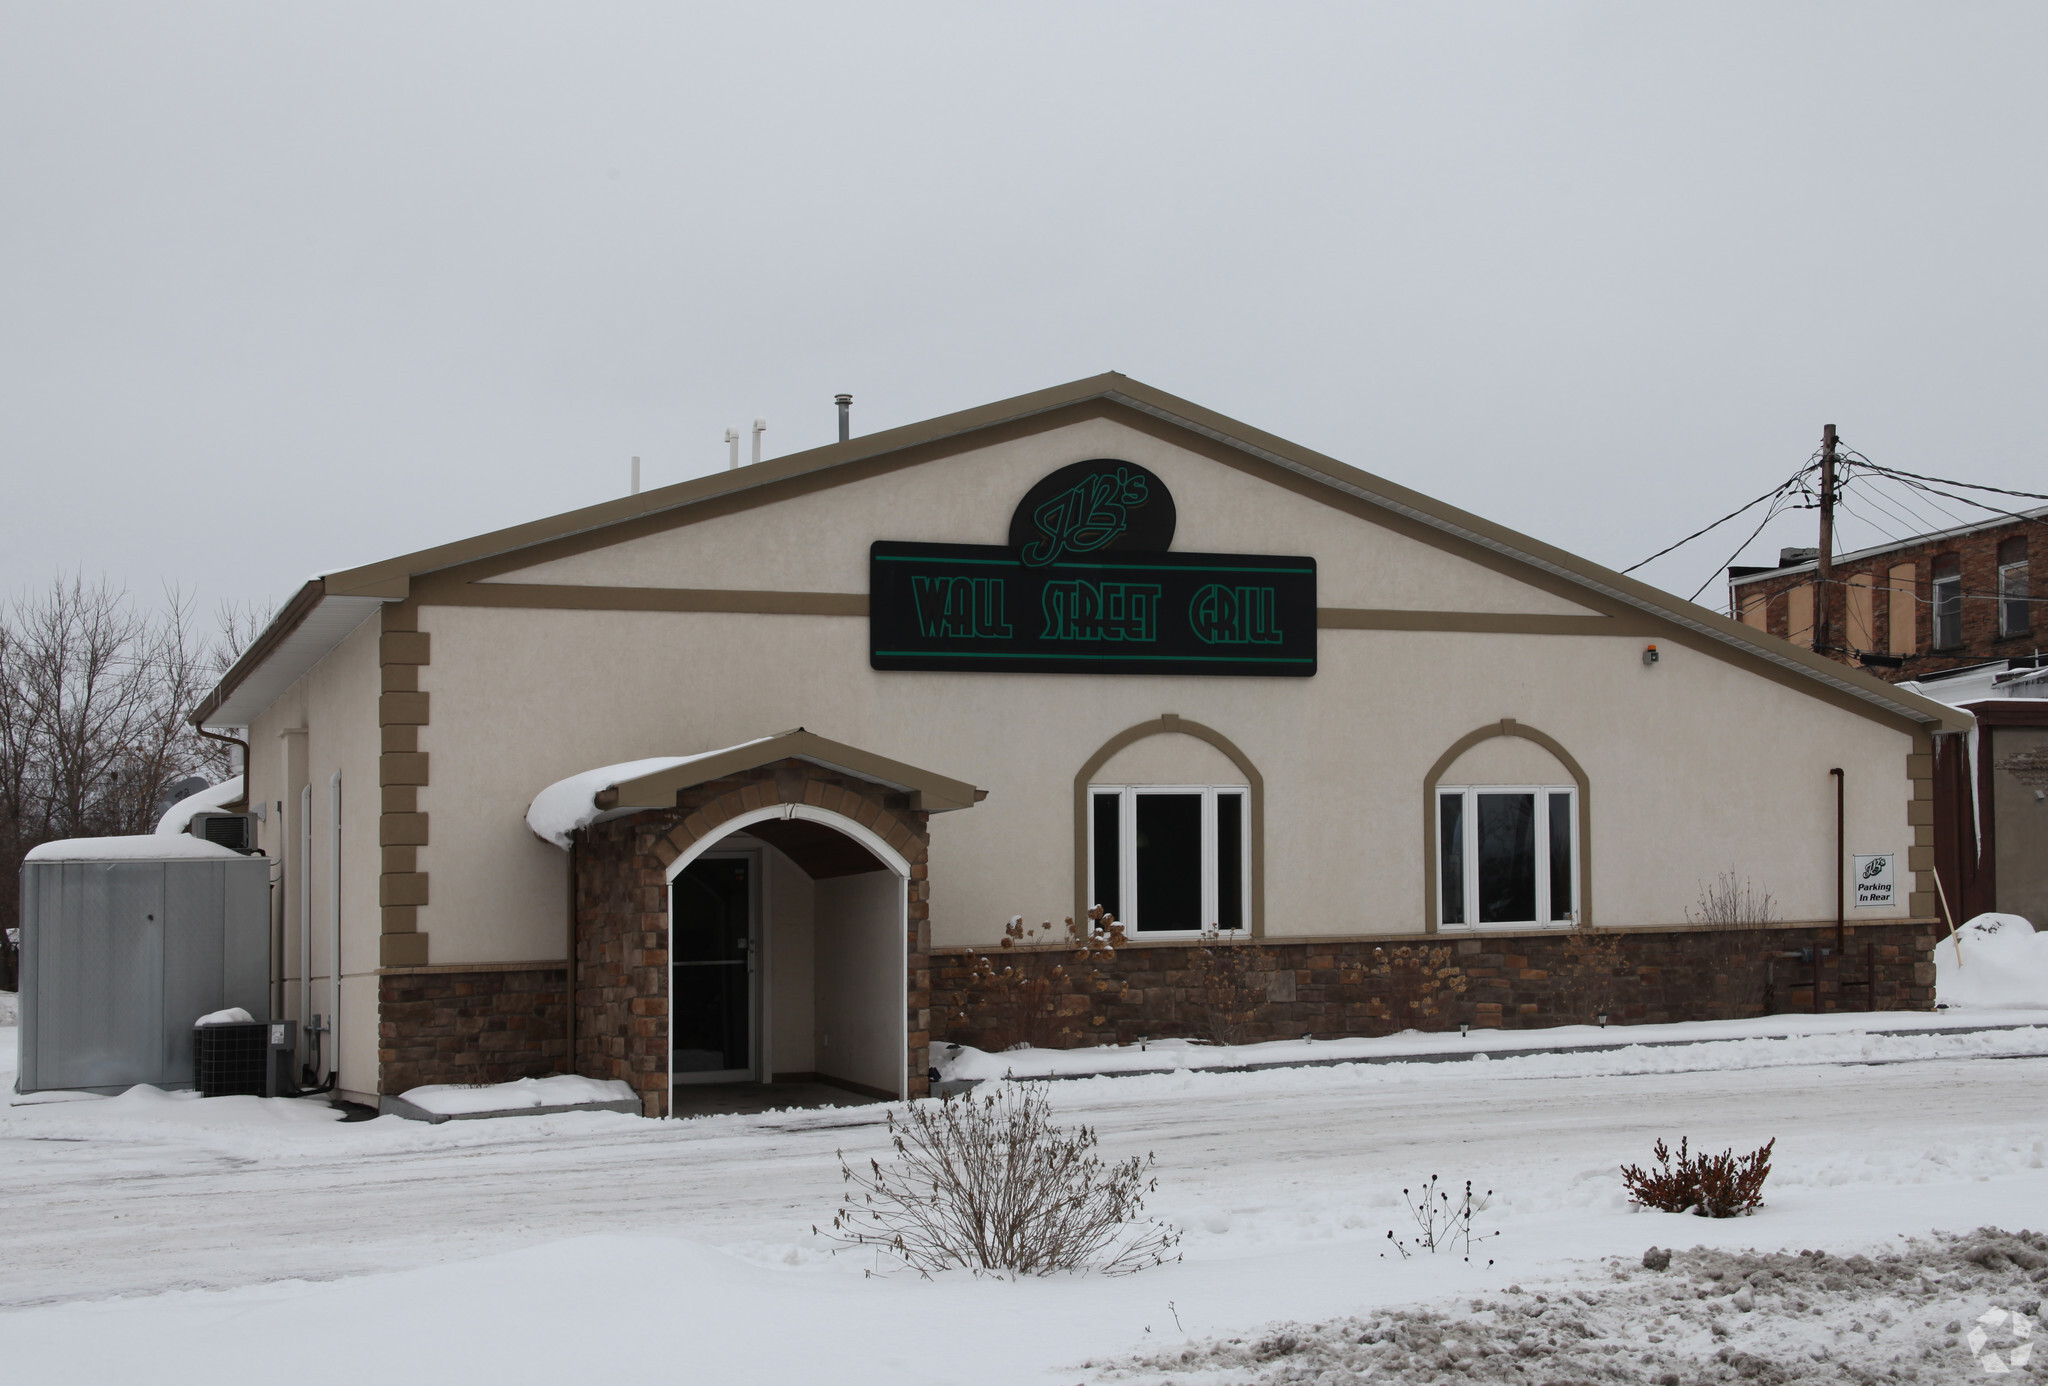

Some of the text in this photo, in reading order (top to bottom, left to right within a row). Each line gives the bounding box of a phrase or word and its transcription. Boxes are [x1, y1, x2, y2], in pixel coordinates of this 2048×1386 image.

[1022, 467, 1149, 567] JB's
[912, 576, 1283, 645] WALL STREET GRILL
[1858, 883, 1891, 892] Parking
